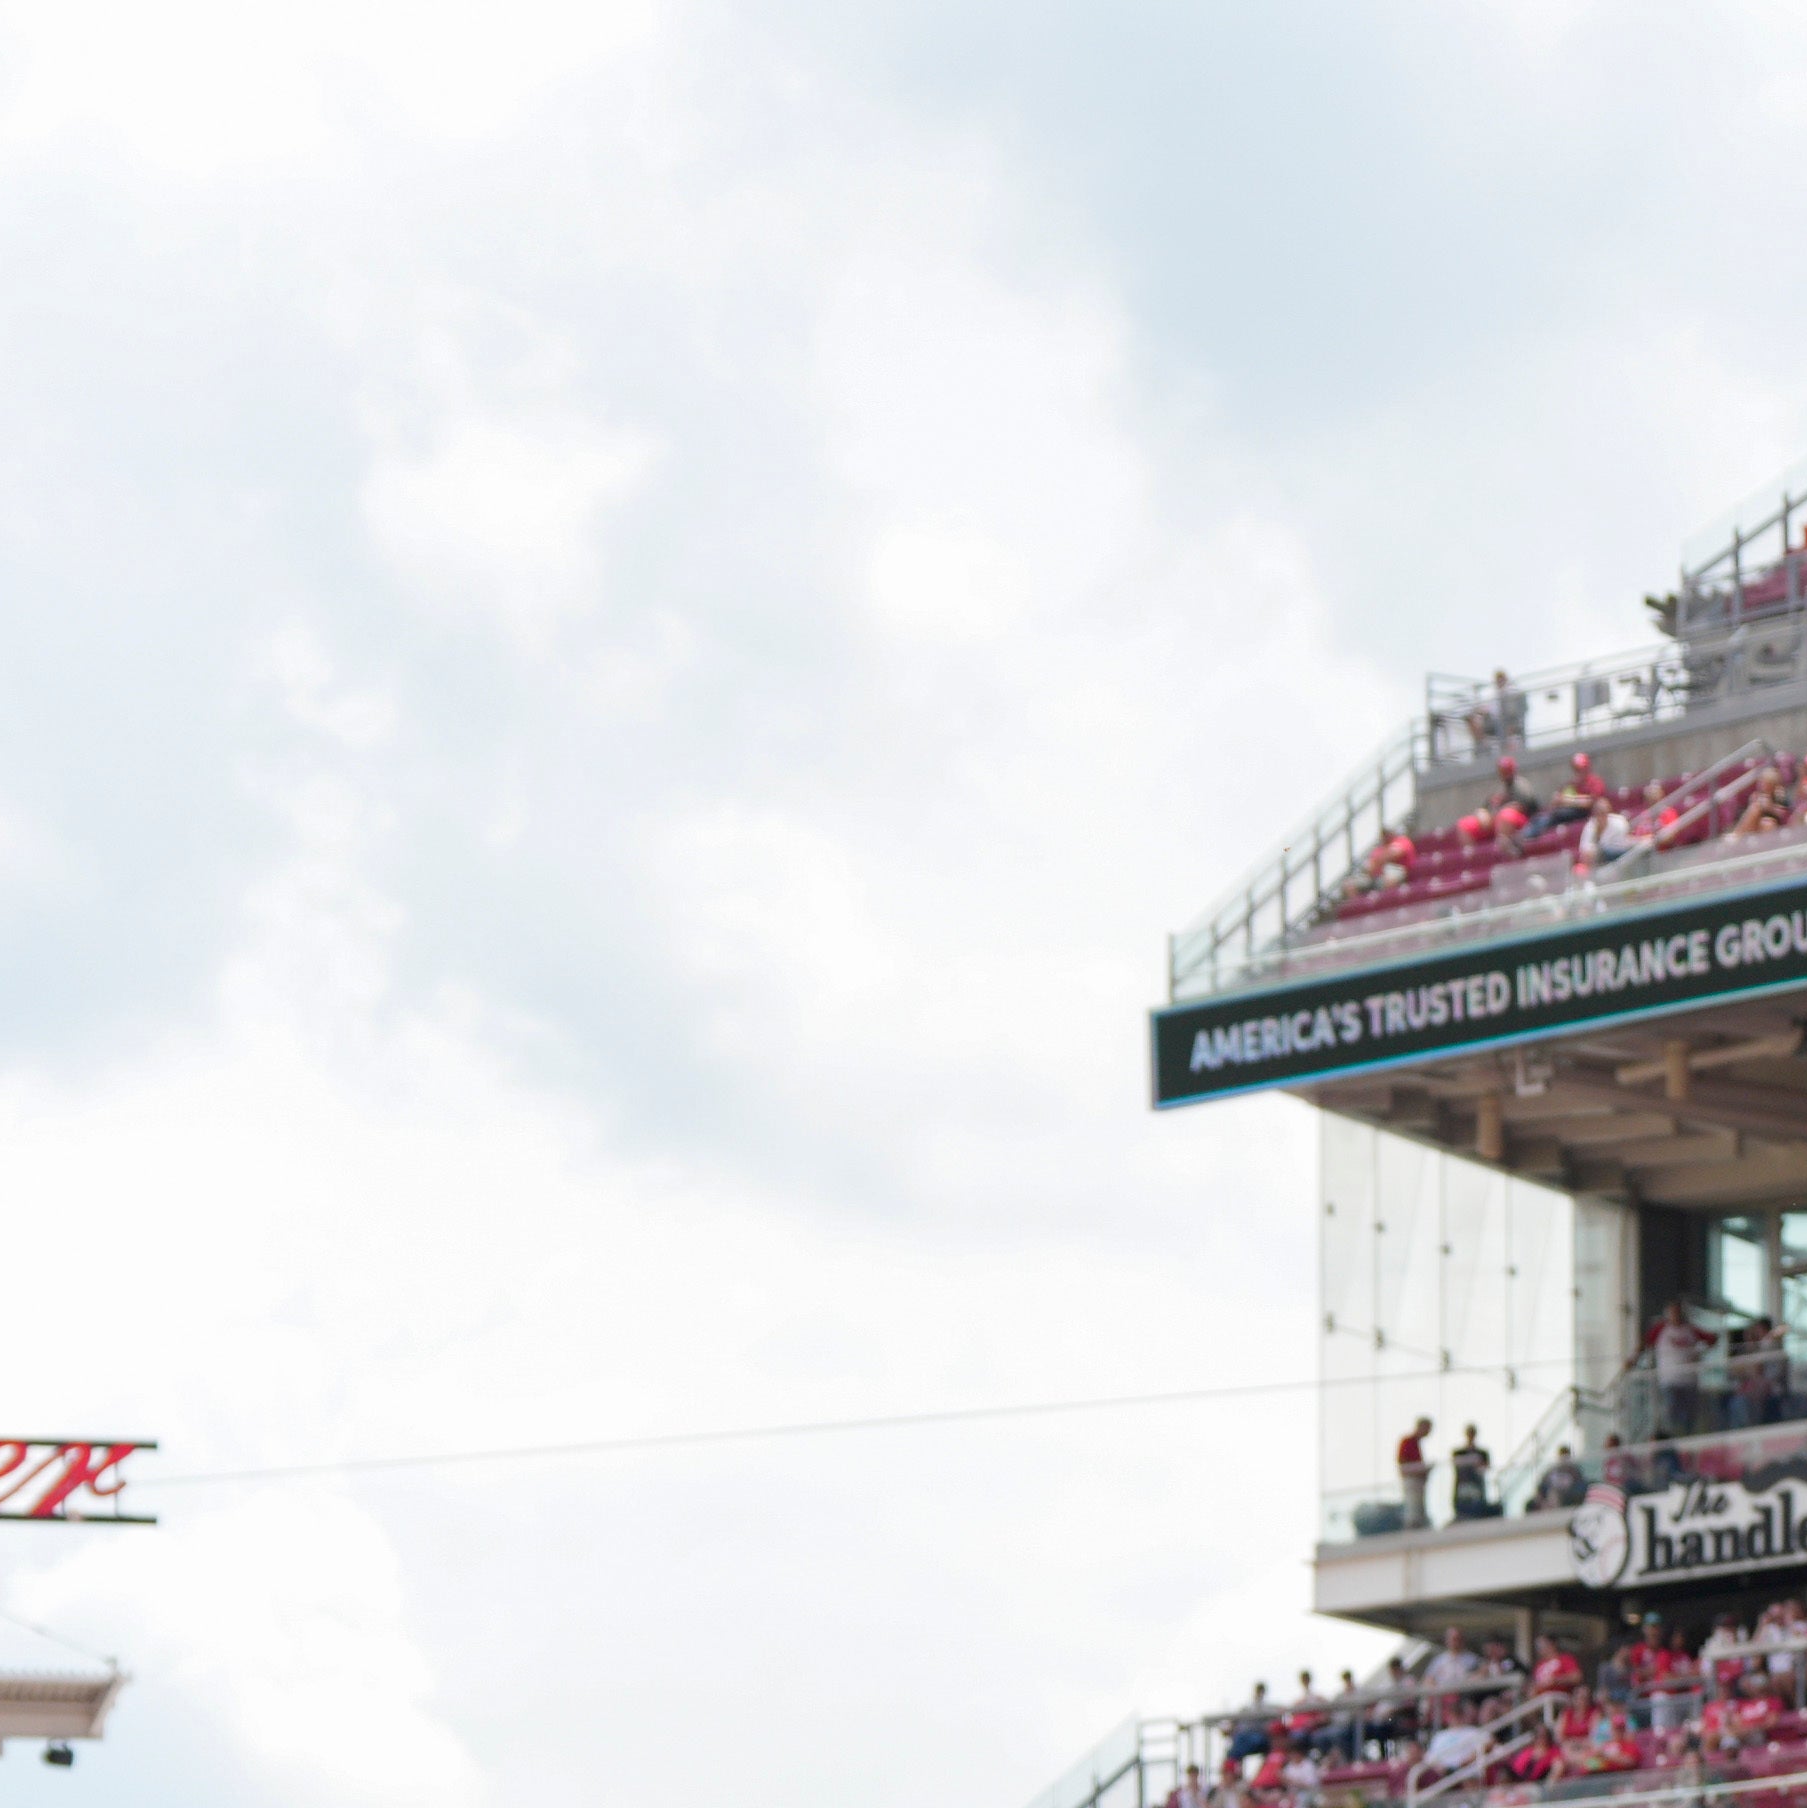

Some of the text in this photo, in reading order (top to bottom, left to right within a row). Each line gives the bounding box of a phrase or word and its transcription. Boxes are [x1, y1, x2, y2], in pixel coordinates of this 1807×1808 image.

[1191, 1000, 1366, 1073] AMERICA'S
[1362, 975, 1512, 1036] TRUSTED
[1515, 929, 1712, 1027] INSURANCE
[1672, 1478, 1733, 1523] The
